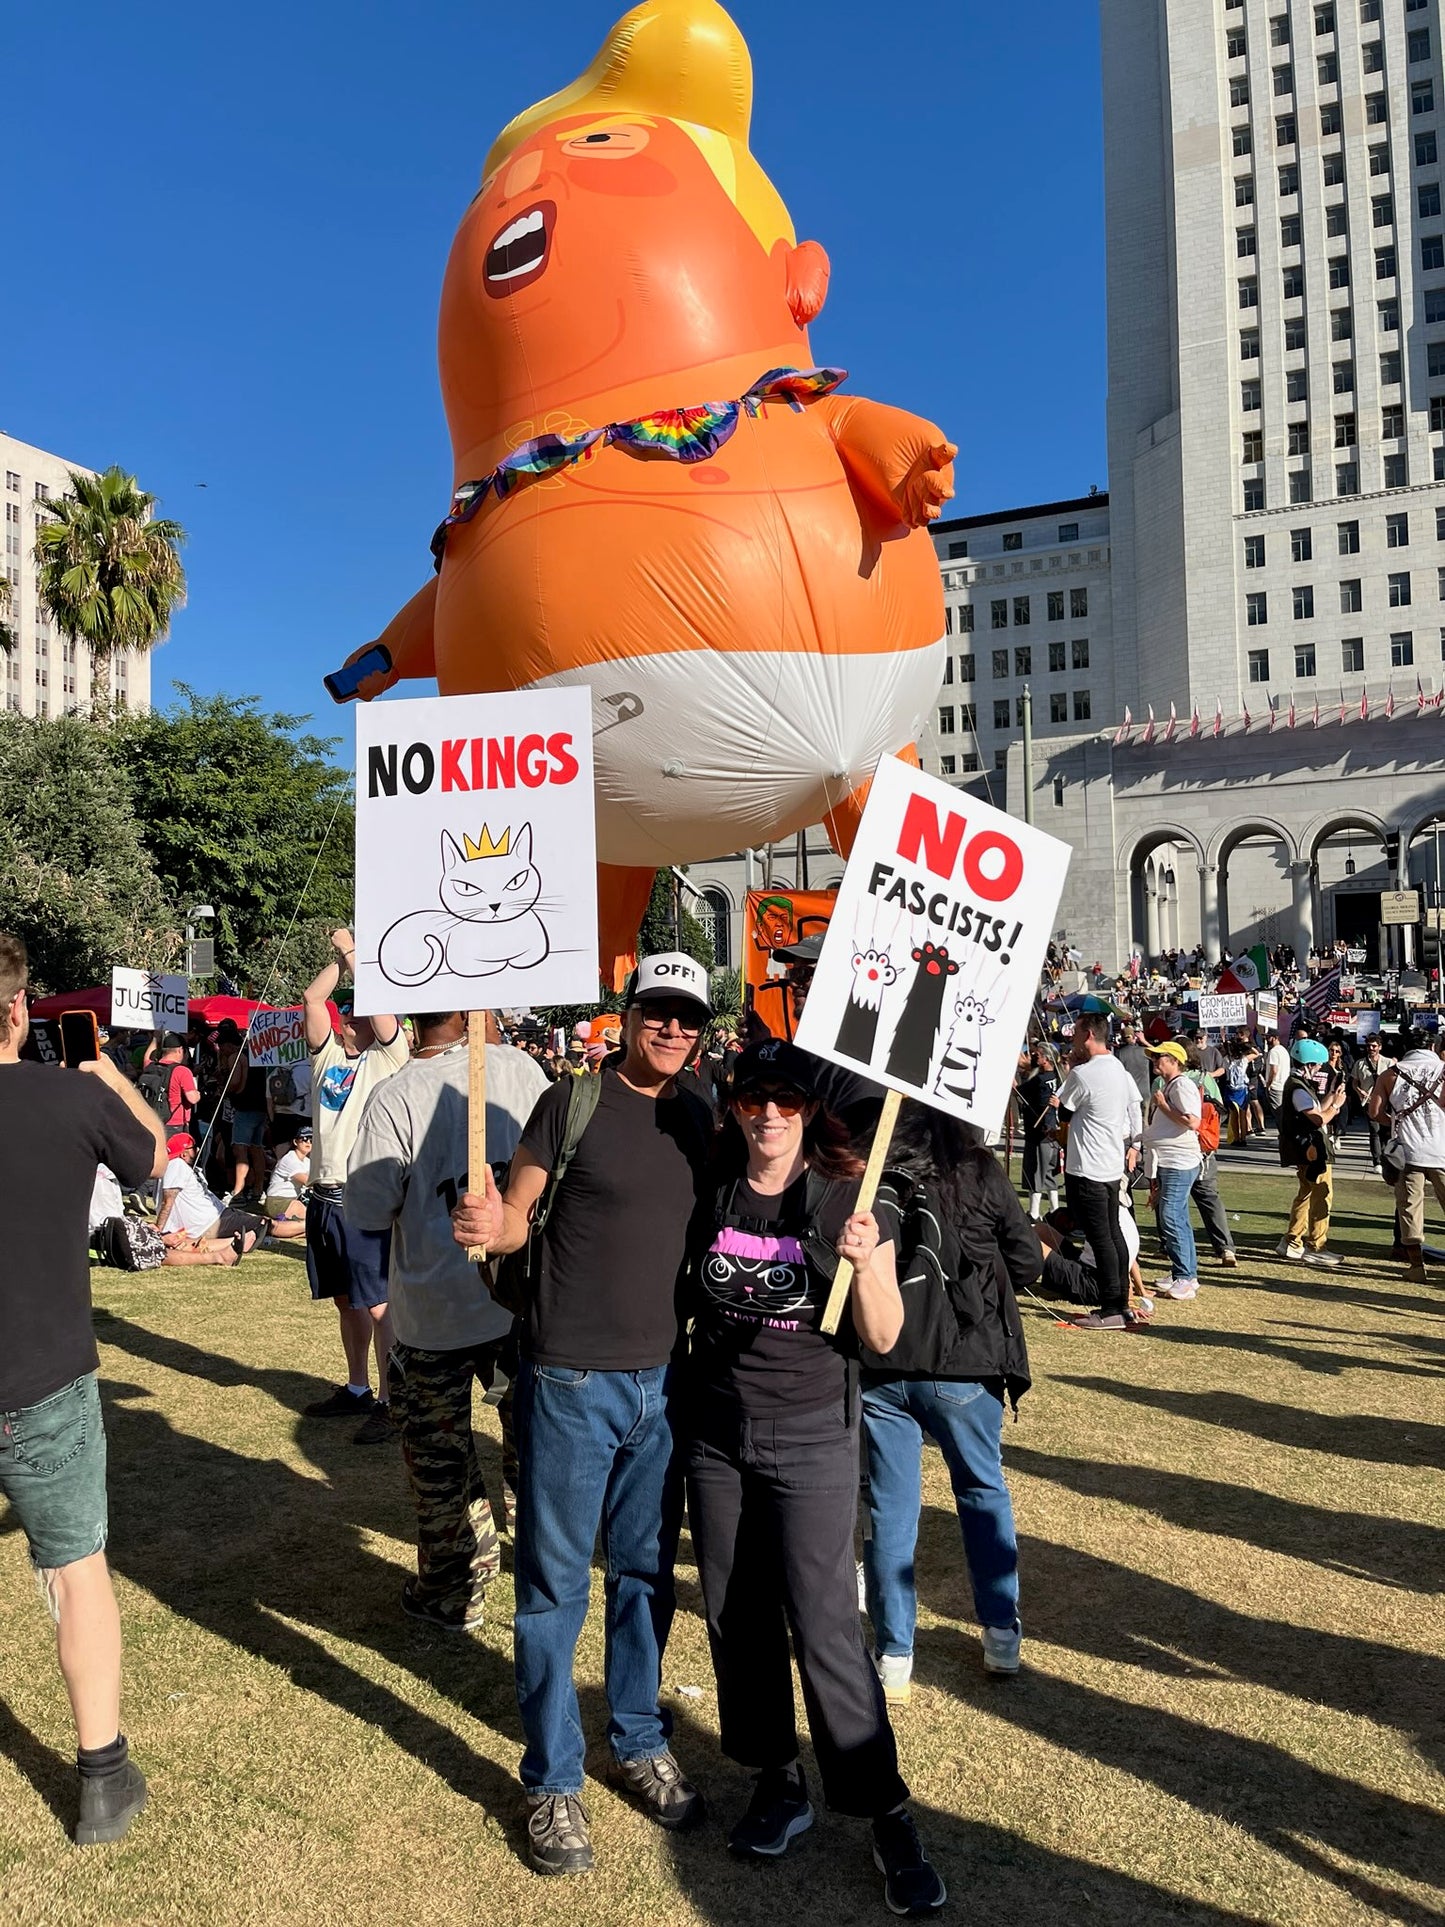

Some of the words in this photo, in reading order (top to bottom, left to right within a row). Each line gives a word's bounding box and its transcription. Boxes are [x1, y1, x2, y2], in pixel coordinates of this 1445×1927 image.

[369, 743, 434, 798] NO
[441, 732, 579, 792] KINGS
[897, 793, 1023, 901] NO
[868, 862, 1022, 965] FASCISTS!
[653, 964, 695, 982] OFF!
[115, 987, 186, 1015] JUSTICE
[1200, 996, 1244, 1008] CROMWELL
[1201, 1008, 1219, 1018] WAS
[1222, 1007, 1245, 1017] RIGHT
[250, 1012, 281, 1034] KEEP
[285, 1011, 300, 1024] UR
[260, 1051, 274, 1065] MY
[277, 1039, 309, 1065] MOUT
